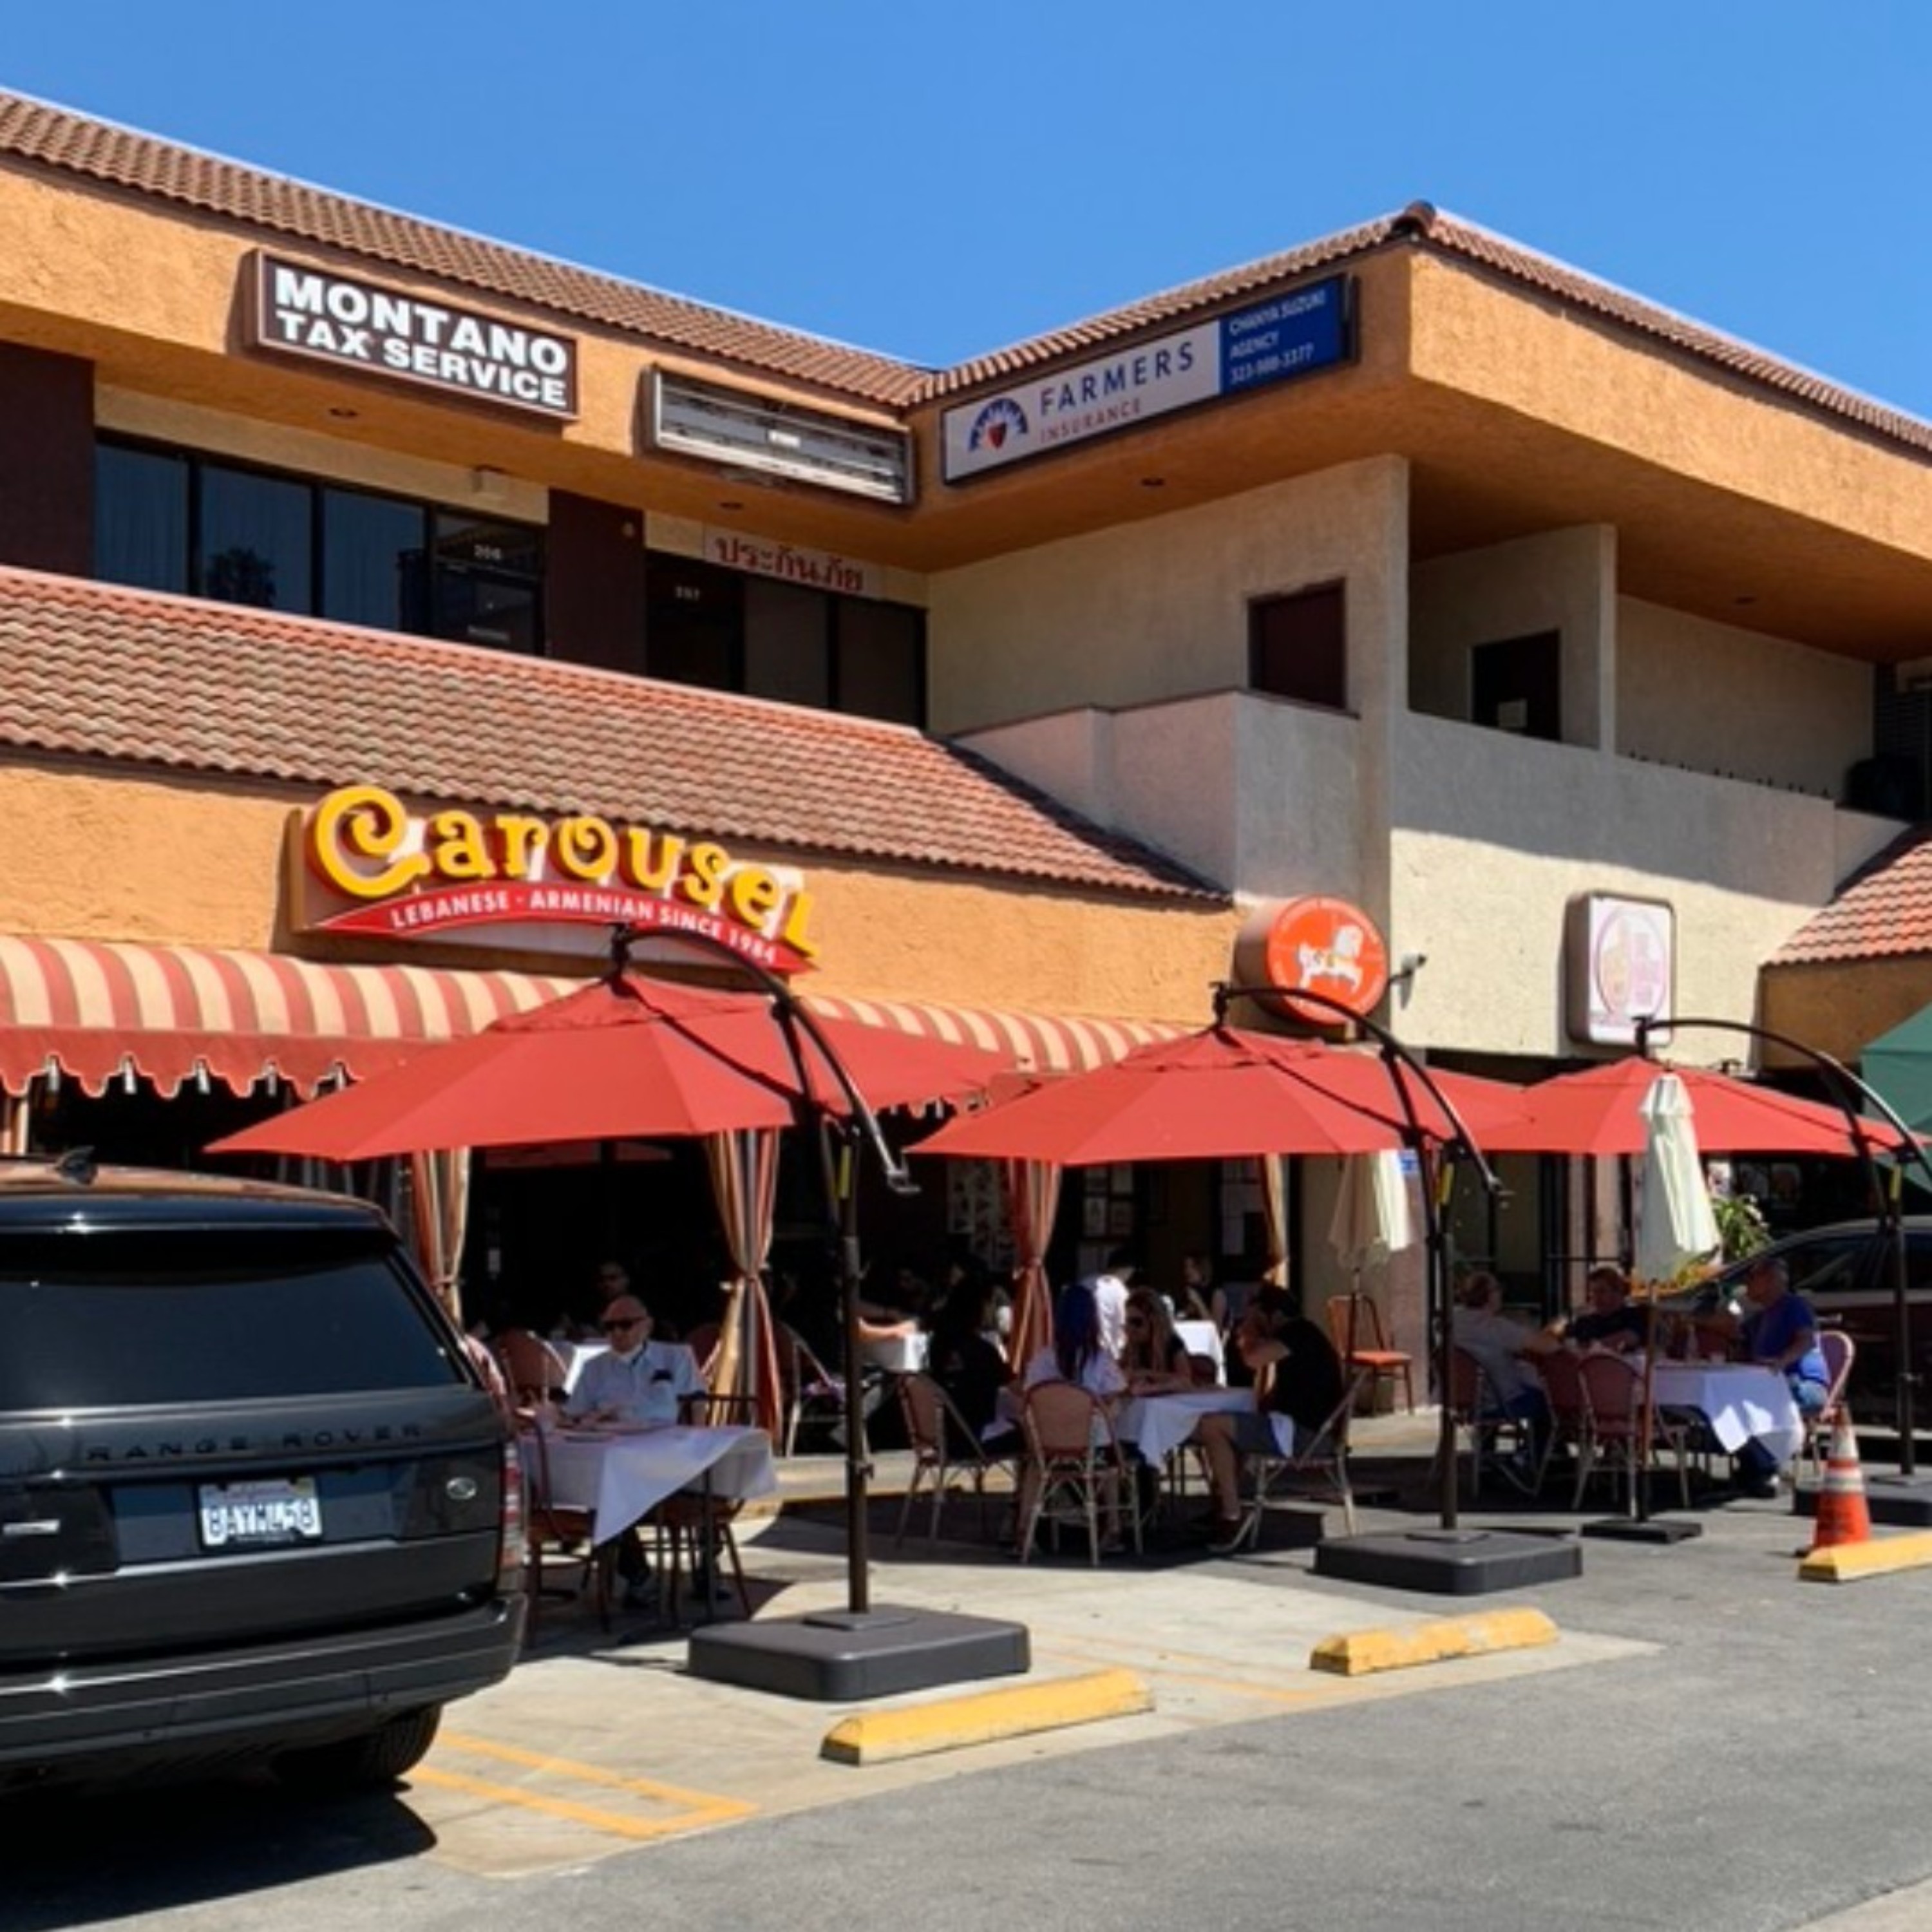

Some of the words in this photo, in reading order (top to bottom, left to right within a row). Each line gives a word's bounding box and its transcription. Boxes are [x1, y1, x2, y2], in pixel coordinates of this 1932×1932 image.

[274, 267, 567, 375] MONTANO
[1230, 330, 1280, 361] AGENCY
[275, 309, 371, 360] TAX
[383, 337, 567, 408] SERVICE
[1040, 341, 1195, 416] FARMERS
[1041, 398, 1141, 444] INSURANCE
[715, 537, 864, 591] ประกันภัย
[390, 890, 509, 928] LEBANESE
[530, 890, 654, 919] ARMENIAN
[659, 907, 724, 939] SINCE
[86, 1436, 249, 1462] RANGE
[282, 1423, 422, 1448] ROVER
